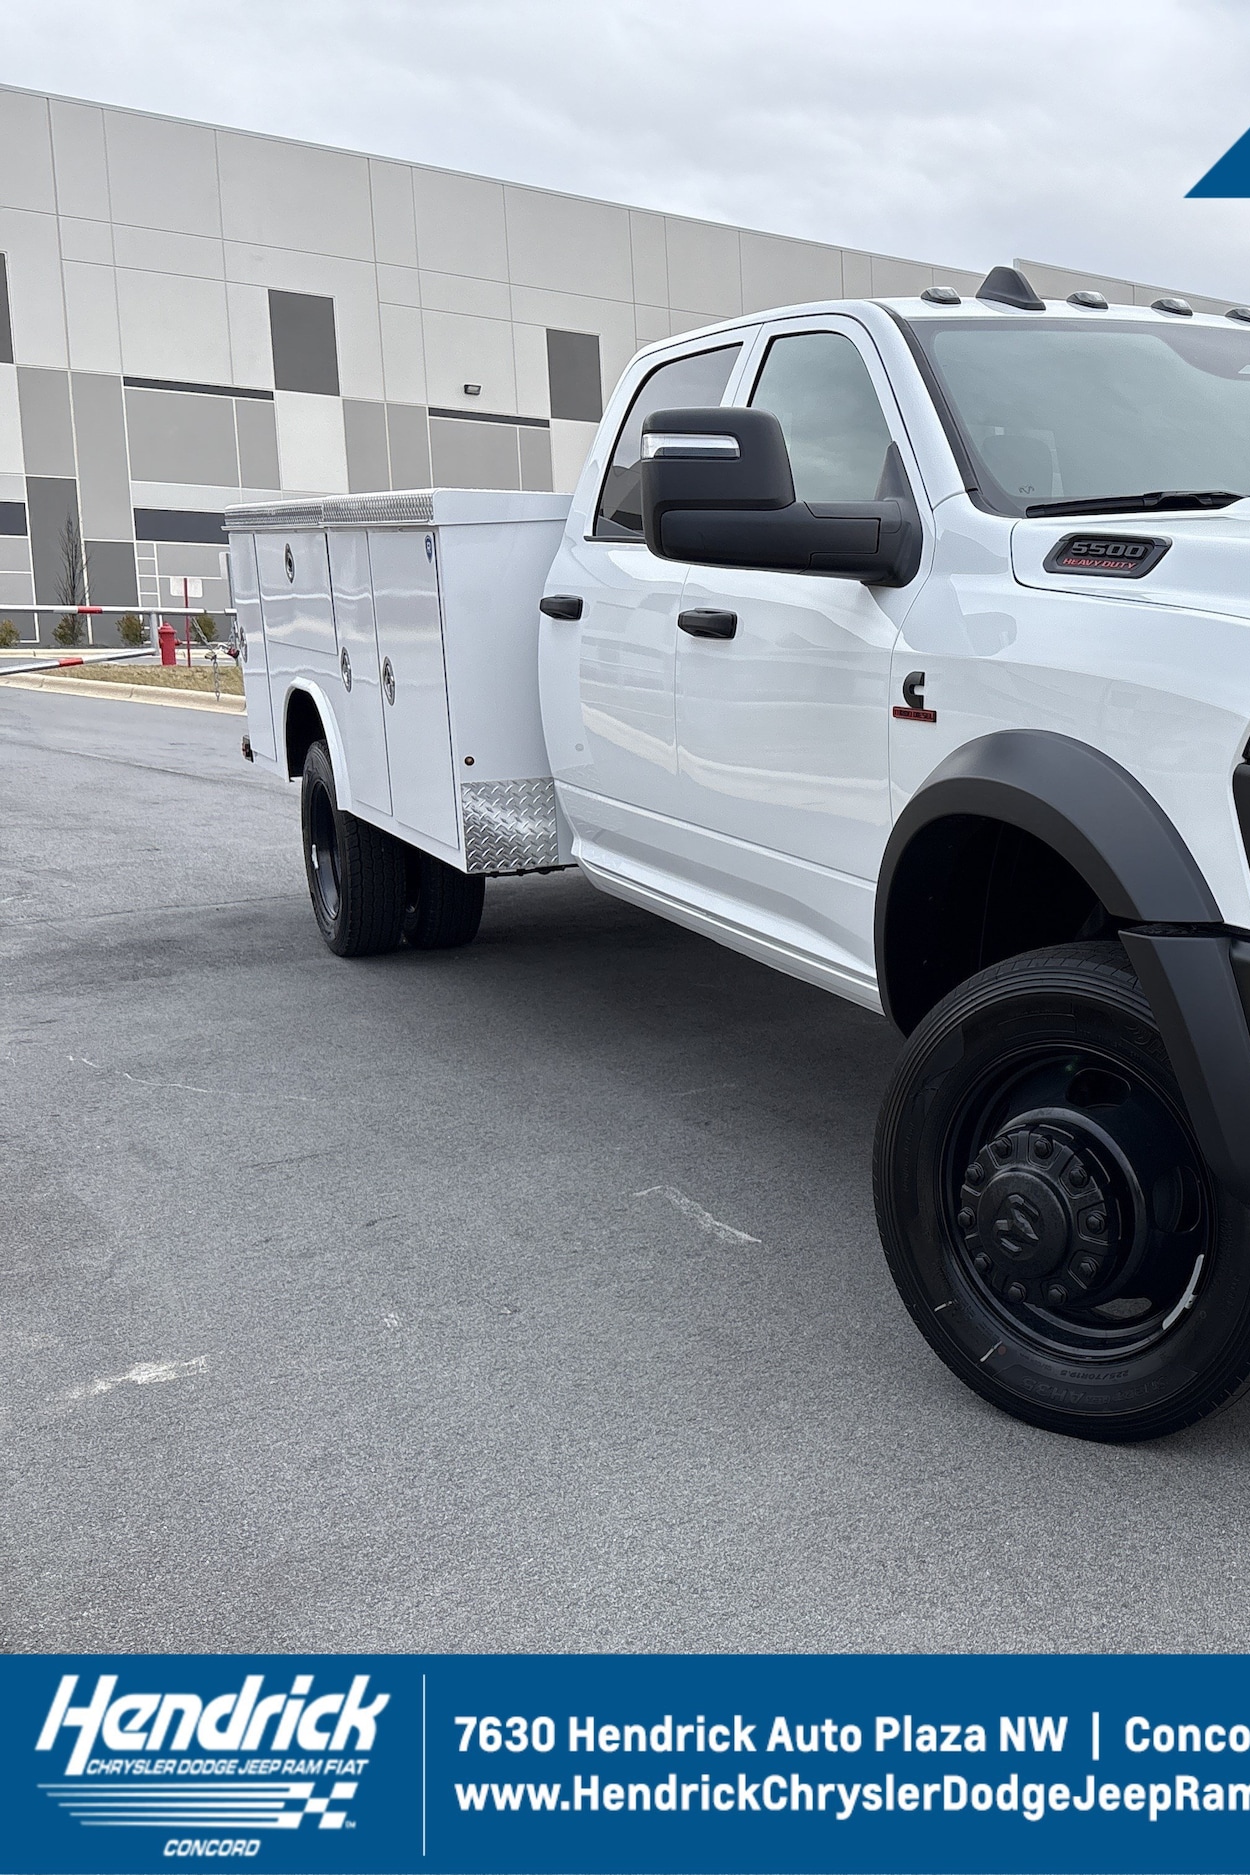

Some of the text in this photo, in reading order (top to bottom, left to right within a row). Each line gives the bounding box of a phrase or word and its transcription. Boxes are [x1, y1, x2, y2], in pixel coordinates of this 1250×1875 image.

[1070, 541, 1146, 558] 5500
[1063, 558, 1137, 570] HEAVY DUTY
